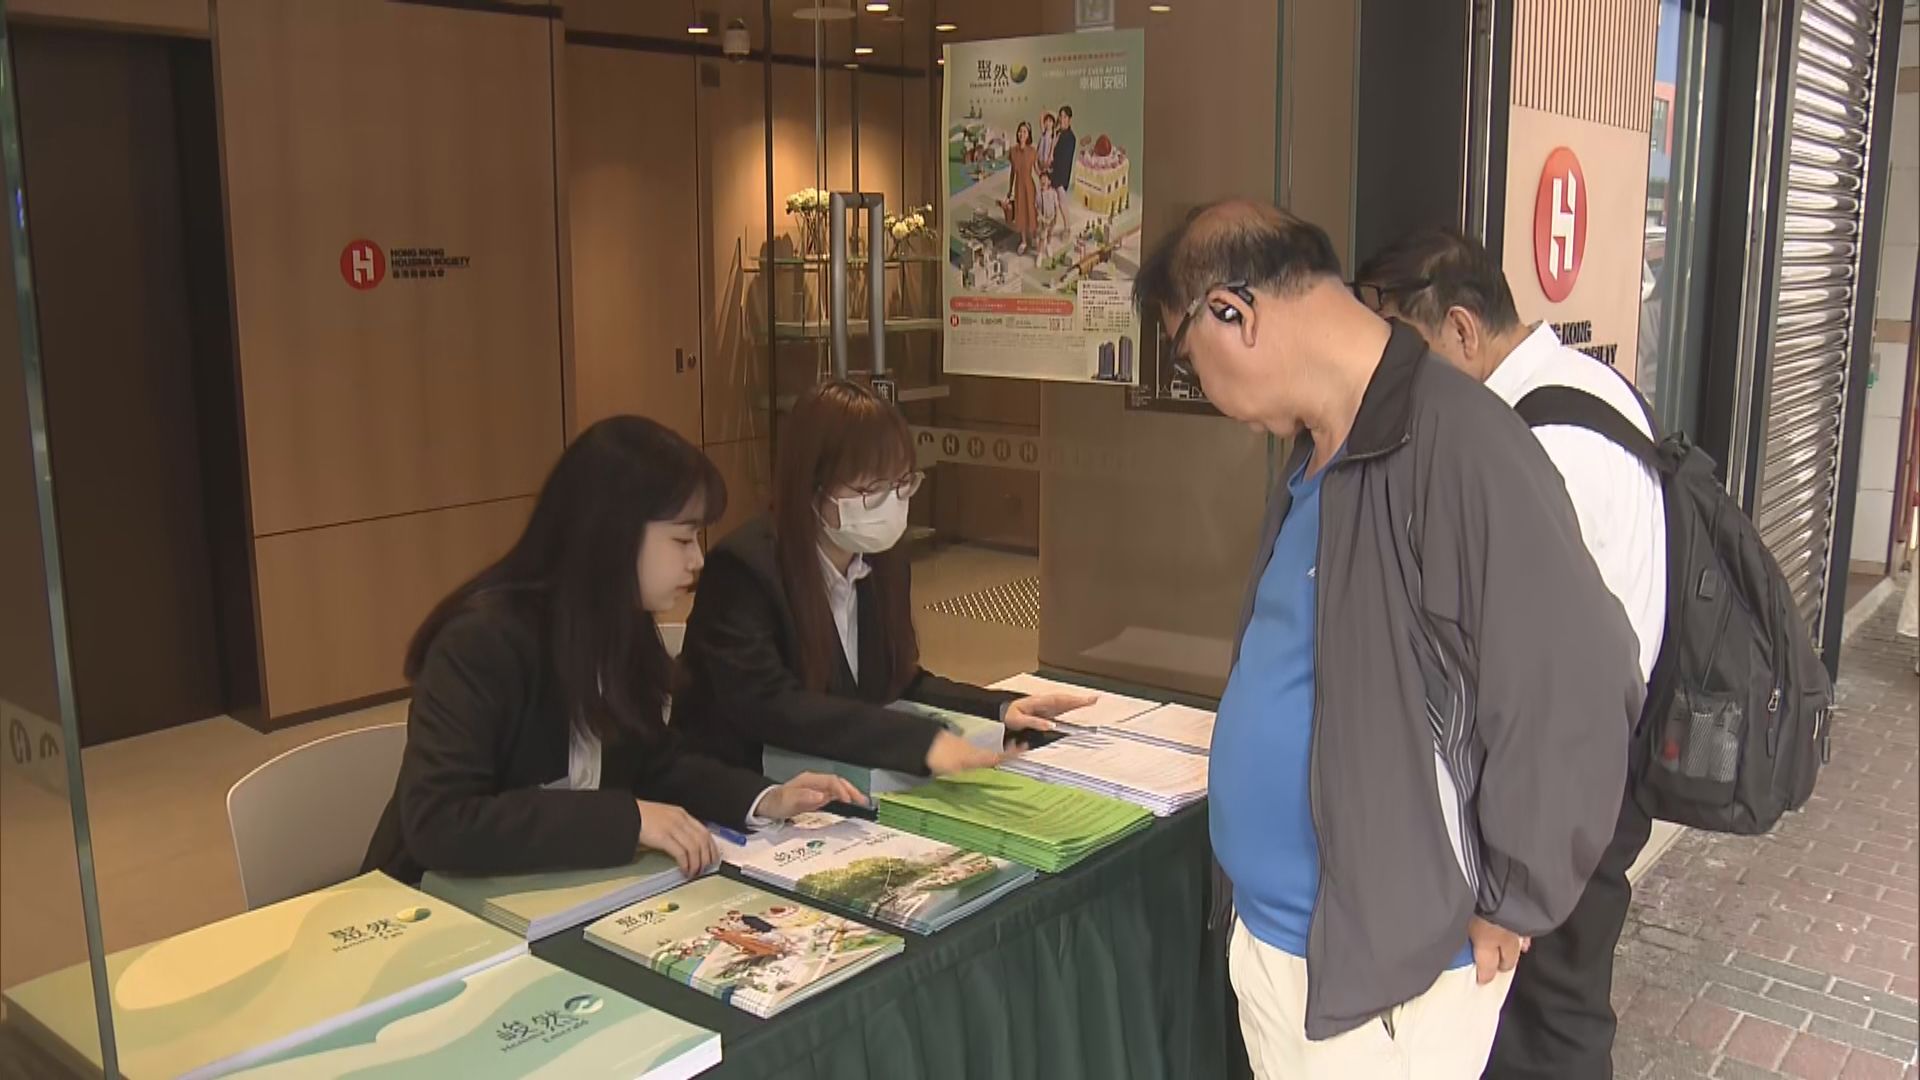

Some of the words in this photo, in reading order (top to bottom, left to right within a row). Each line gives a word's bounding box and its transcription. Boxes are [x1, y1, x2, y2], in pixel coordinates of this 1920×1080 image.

[390, 247, 417, 257] HONG
[419, 247, 445, 257] KONG
[1562, 320, 1592, 345] KONG
